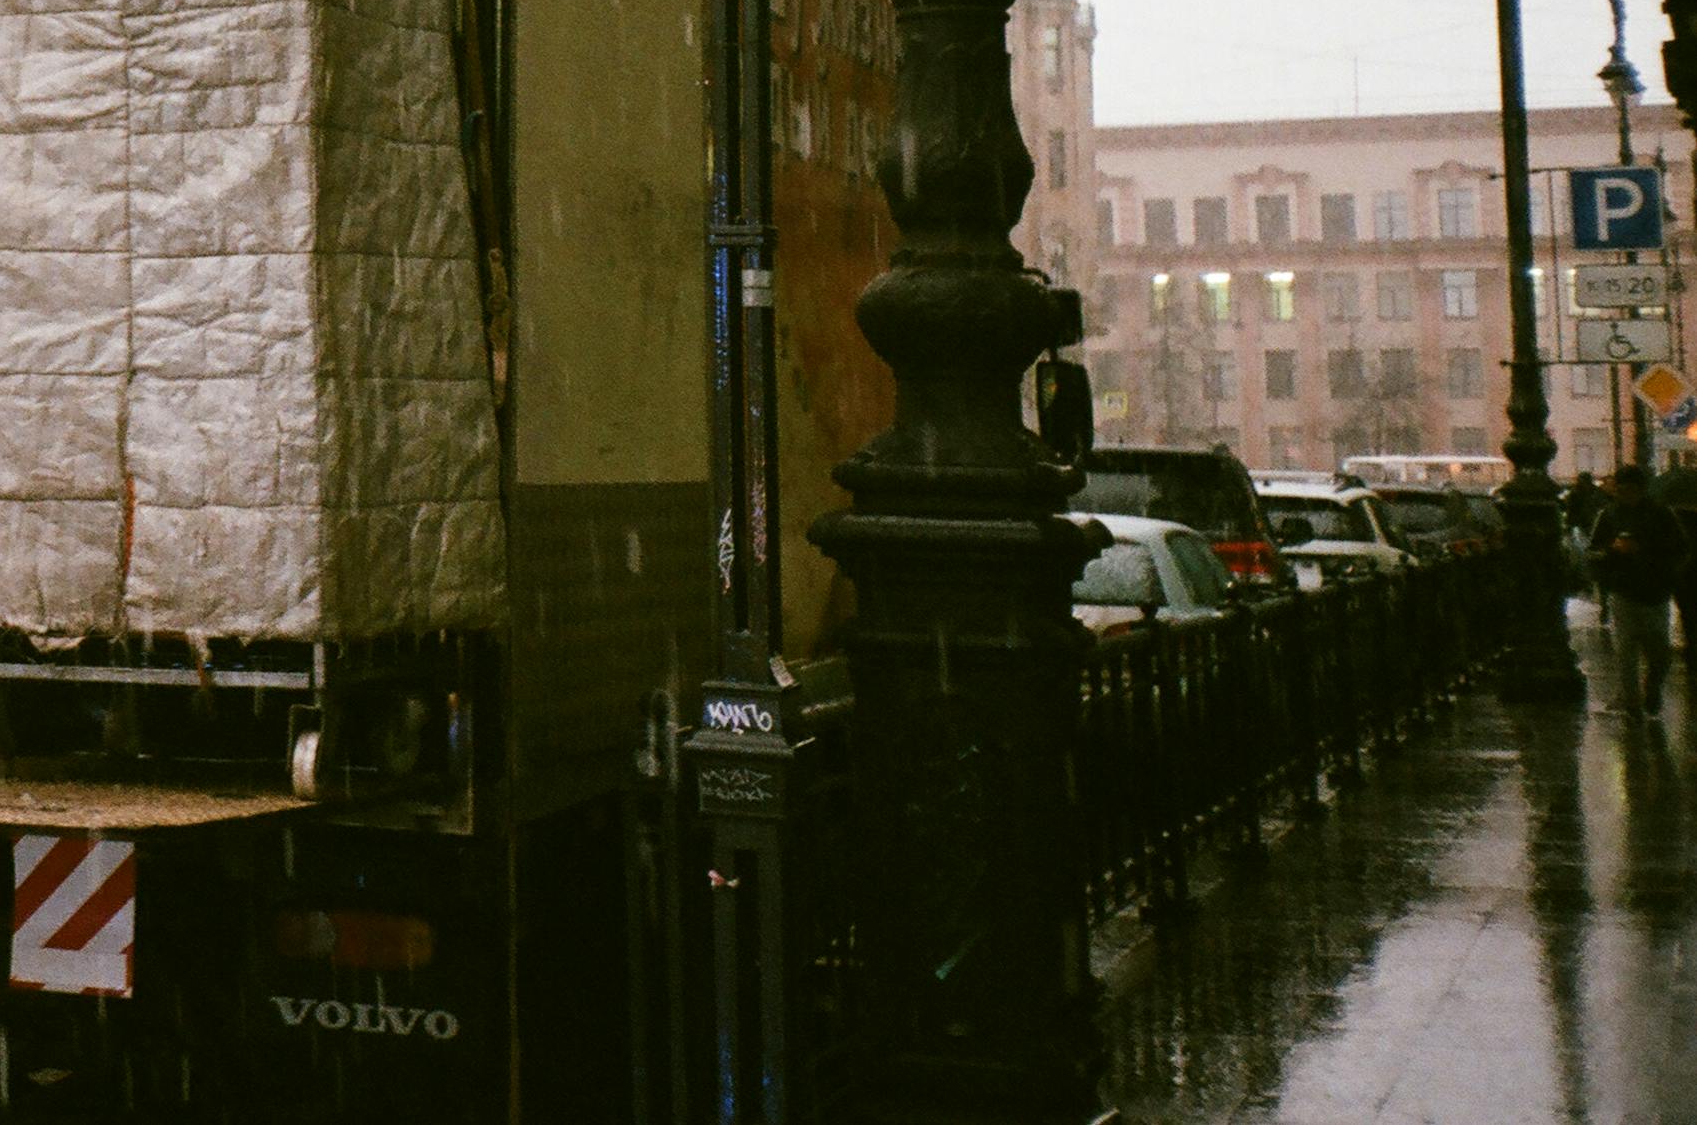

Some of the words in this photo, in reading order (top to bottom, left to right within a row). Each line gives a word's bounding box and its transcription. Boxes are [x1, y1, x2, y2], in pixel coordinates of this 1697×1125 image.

[1594, 178, 1645, 242] P
[1606, 278, 1621, 294] 15
[1628, 277, 1655, 295] 20
[269, 995, 460, 1040] VOLVO
